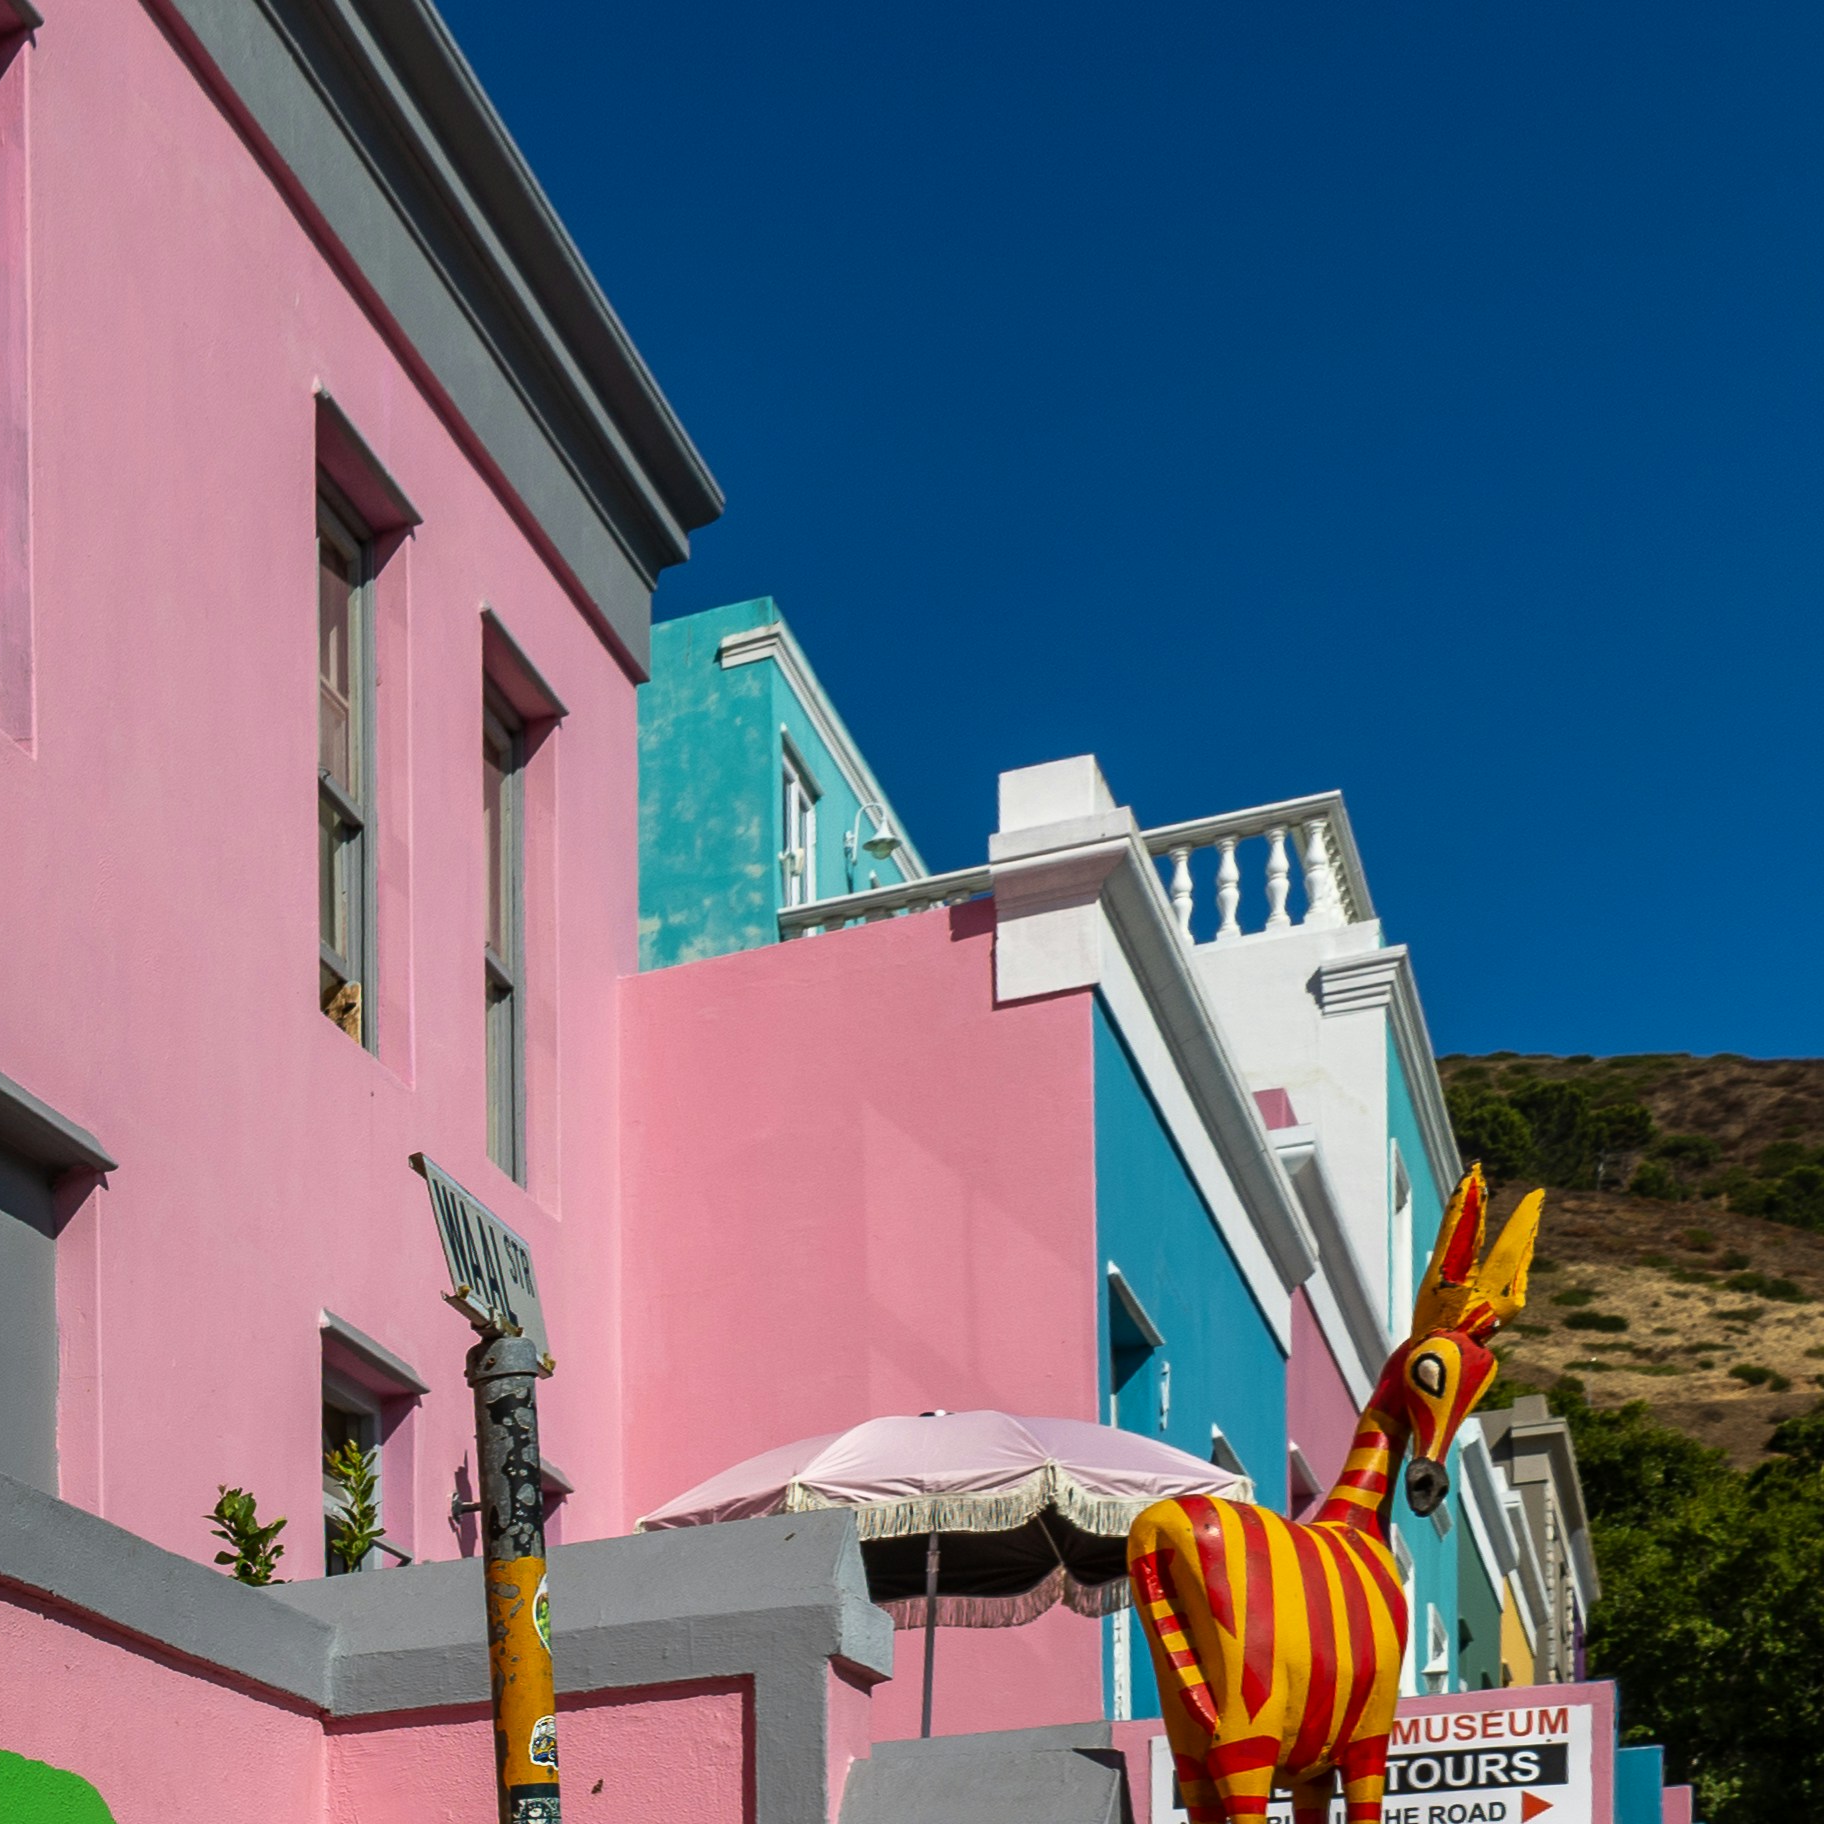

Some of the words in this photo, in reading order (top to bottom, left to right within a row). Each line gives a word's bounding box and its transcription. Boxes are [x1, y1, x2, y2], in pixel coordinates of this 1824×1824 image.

[432, 1178, 519, 1328] WAAL
[1392, 1707, 1569, 1745] MUSEUM
[1385, 1751, 1541, 1791] TOURS
